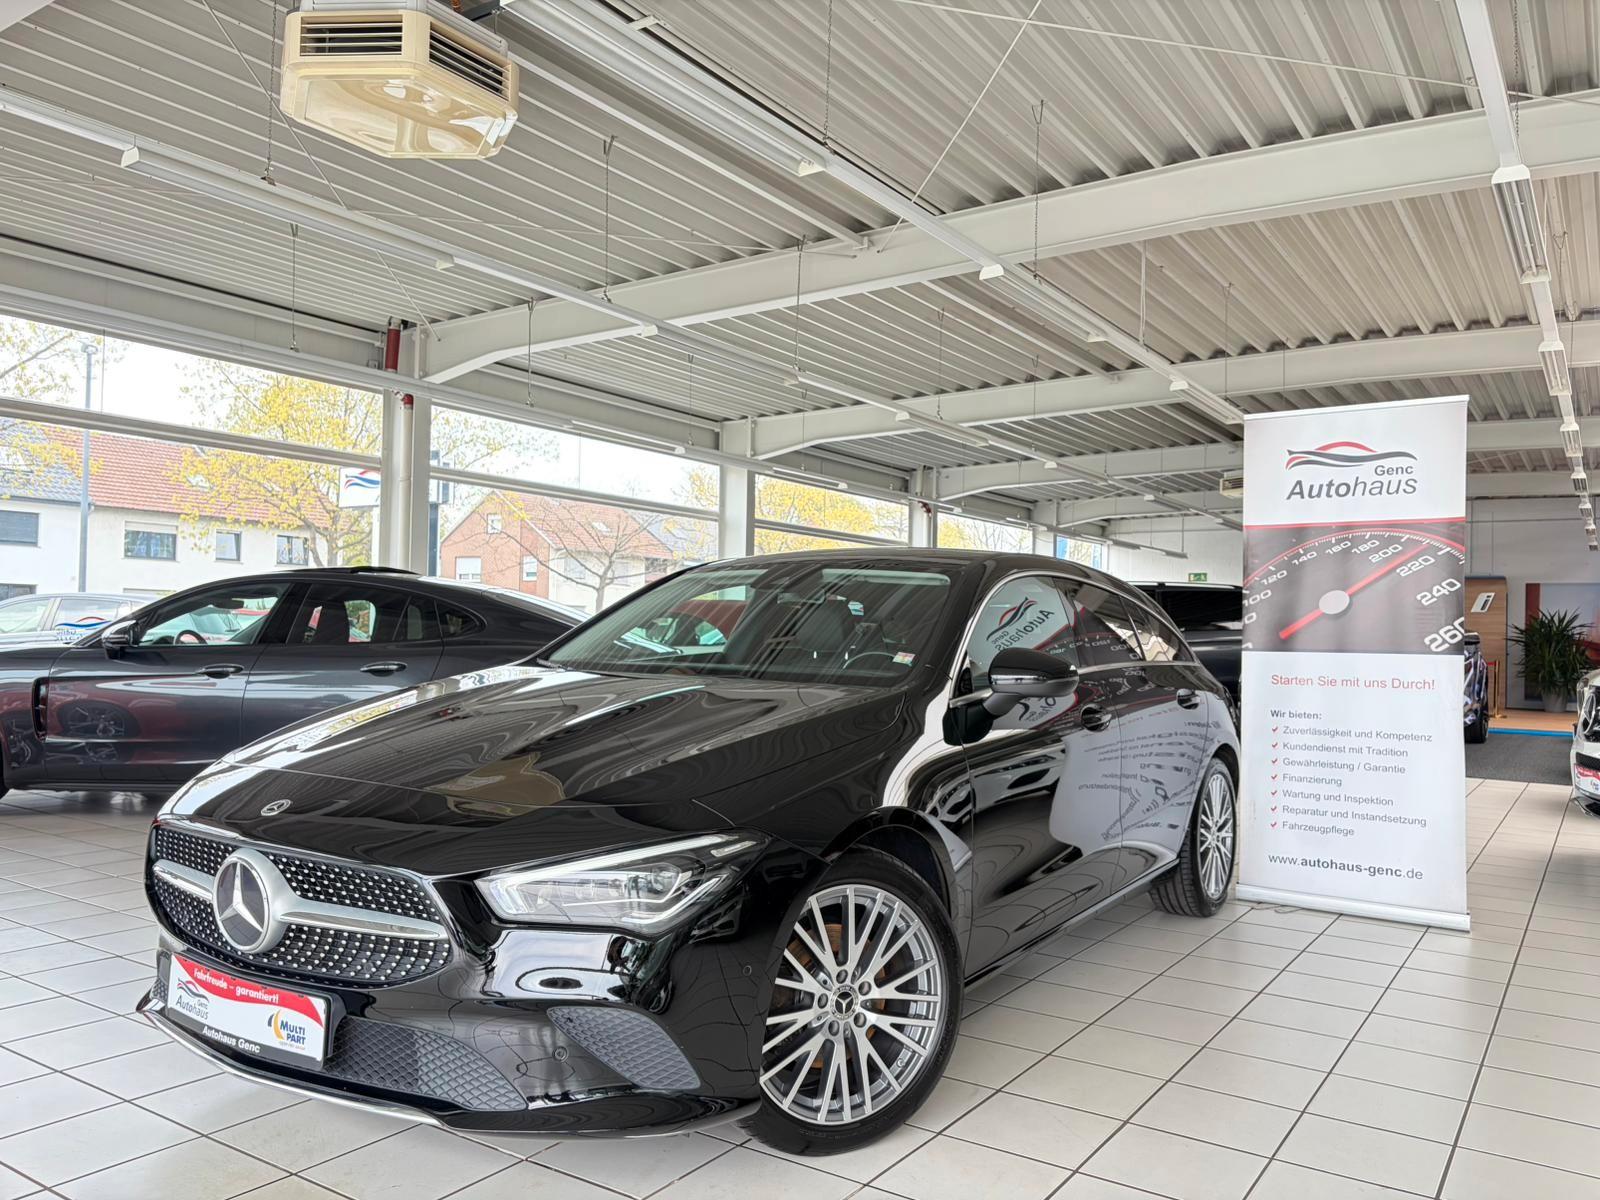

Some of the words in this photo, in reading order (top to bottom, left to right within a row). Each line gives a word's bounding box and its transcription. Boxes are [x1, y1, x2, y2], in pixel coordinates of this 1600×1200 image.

[1374, 464, 1414, 476] Genc
[1286, 476, 1418, 500] Autohaus
[1352, 540, 1379, 554] 180
[1369, 544, 1403, 563] 200
[1291, 551, 1317, 565] 140
[1396, 555, 1436, 577] 220
[1260, 570, 1288, 585] 120
[1416, 578, 1461, 606] 240
[1271, 674, 1313, 686] Starten
[1317, 675, 1337, 687] Sie
[1341, 677, 1360, 688] mit
[1364, 680, 1387, 689] uns
[1391, 678, 1435, 690] Durch!
[1270, 709, 1286, 719] Wir
[1288, 710, 1322, 720] bieten:
[1283, 726, 1351, 739] Zuverlässigkeit
[1354, 730, 1373, 739] und
[1375, 731, 1432, 743] Kompetenz
[1282, 742, 1346, 754] Kundendienst
[1348, 745, 1364, 755] mit
[1365, 746, 1409, 757] Tradition
[1282, 757, 1355, 772] Gewährleistung
[1363, 762, 1406, 774] Garantie
[1282, 773, 1342, 787] Finanzierung
[1282, 789, 1321, 801] Wartung
[1323, 792, 1341, 802] und
[1344, 794, 1394, 807] Inspektion
[1282, 805, 1328, 818] Reparatur
[1330, 810, 1349, 819] und
[1351, 811, 1427, 828] Instandsetzung
[1282, 821, 1355, 837] Fahrzeugpflege
[1268, 854, 1424, 880] www.autohaus-genc.de
[193, 968, 228, 990] Fahrfreude
[236, 986, 279, 1004] garantiert!
[176, 995, 209, 1020] Autohaus
[280, 1019, 306, 1036] MULTI
[202, 1026, 237, 1047] Autohaus
[237, 1039, 261, 1054] Genc
[286, 1033, 307, 1046] PART
